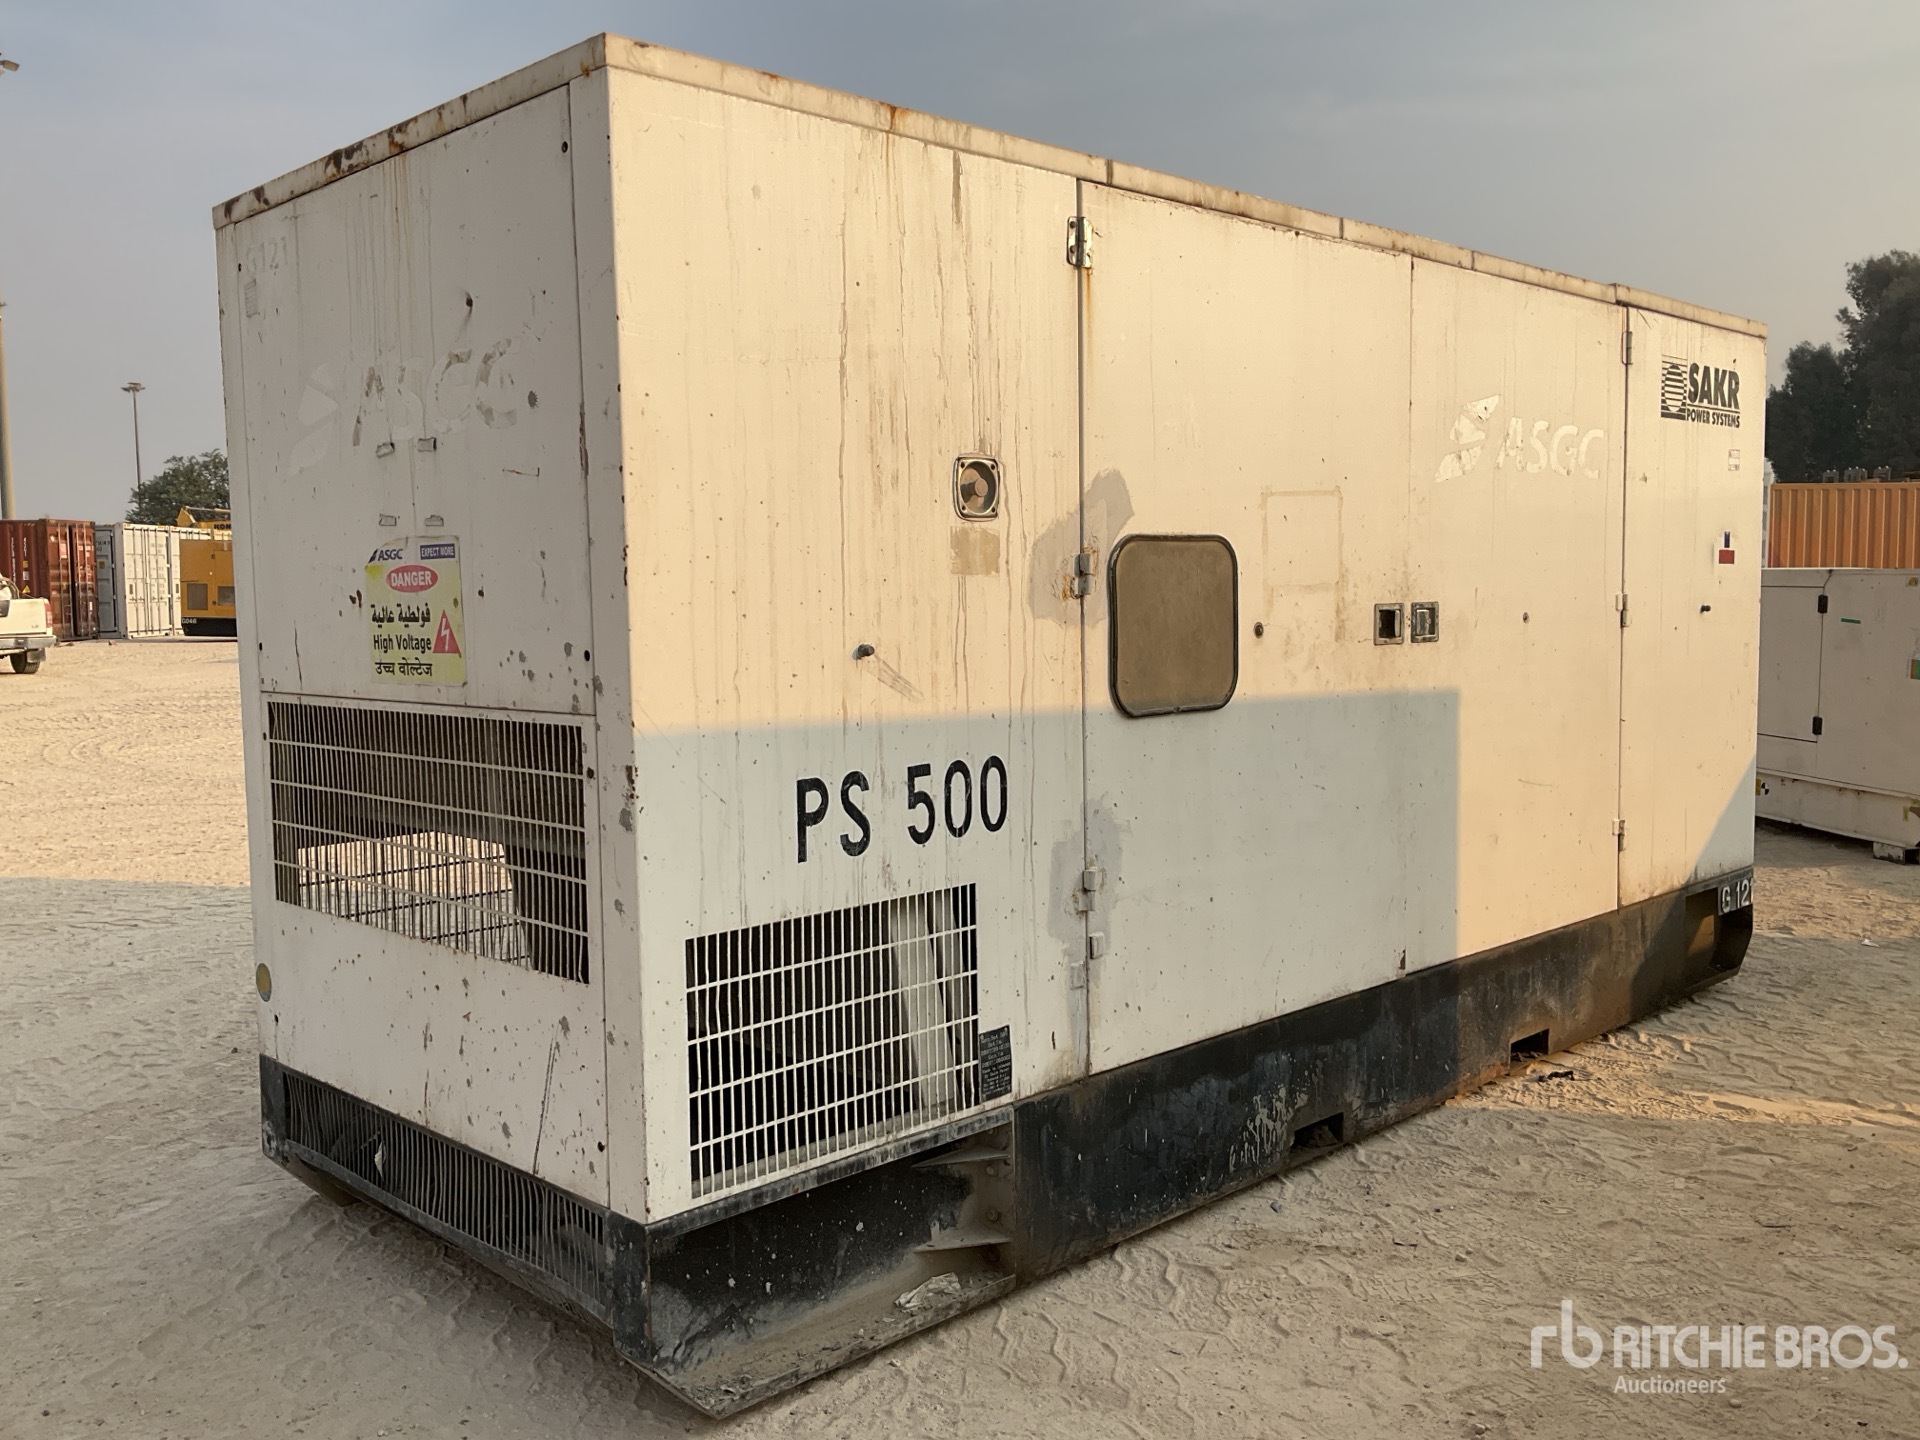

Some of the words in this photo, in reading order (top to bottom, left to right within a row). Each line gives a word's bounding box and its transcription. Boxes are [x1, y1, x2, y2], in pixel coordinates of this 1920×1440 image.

[1687, 362, 1740, 410] SAKR
[1686, 408, 1710, 425] POWER
[1711, 412, 1740, 429] SYSTEMS
[1495, 416, 1605, 479] ASGC
[377, 549, 403, 562] ASGC
[421, 547, 439, 557] EXPECT
[440, 545, 455, 556] MORE
[390, 570, 432, 587] DANGER
[370, 603, 395, 629] عالية
[396, 602, 431, 628] فولطية
[373, 634, 394, 654] High
[395, 634, 432, 654] Voltage
[375, 660, 395, 676] उच्च
[397, 657, 433, 677] वोल्टेज
[796, 770, 871, 864] PS
[907, 755, 1008, 845] 500
[1722, 886, 1731, 913] G
